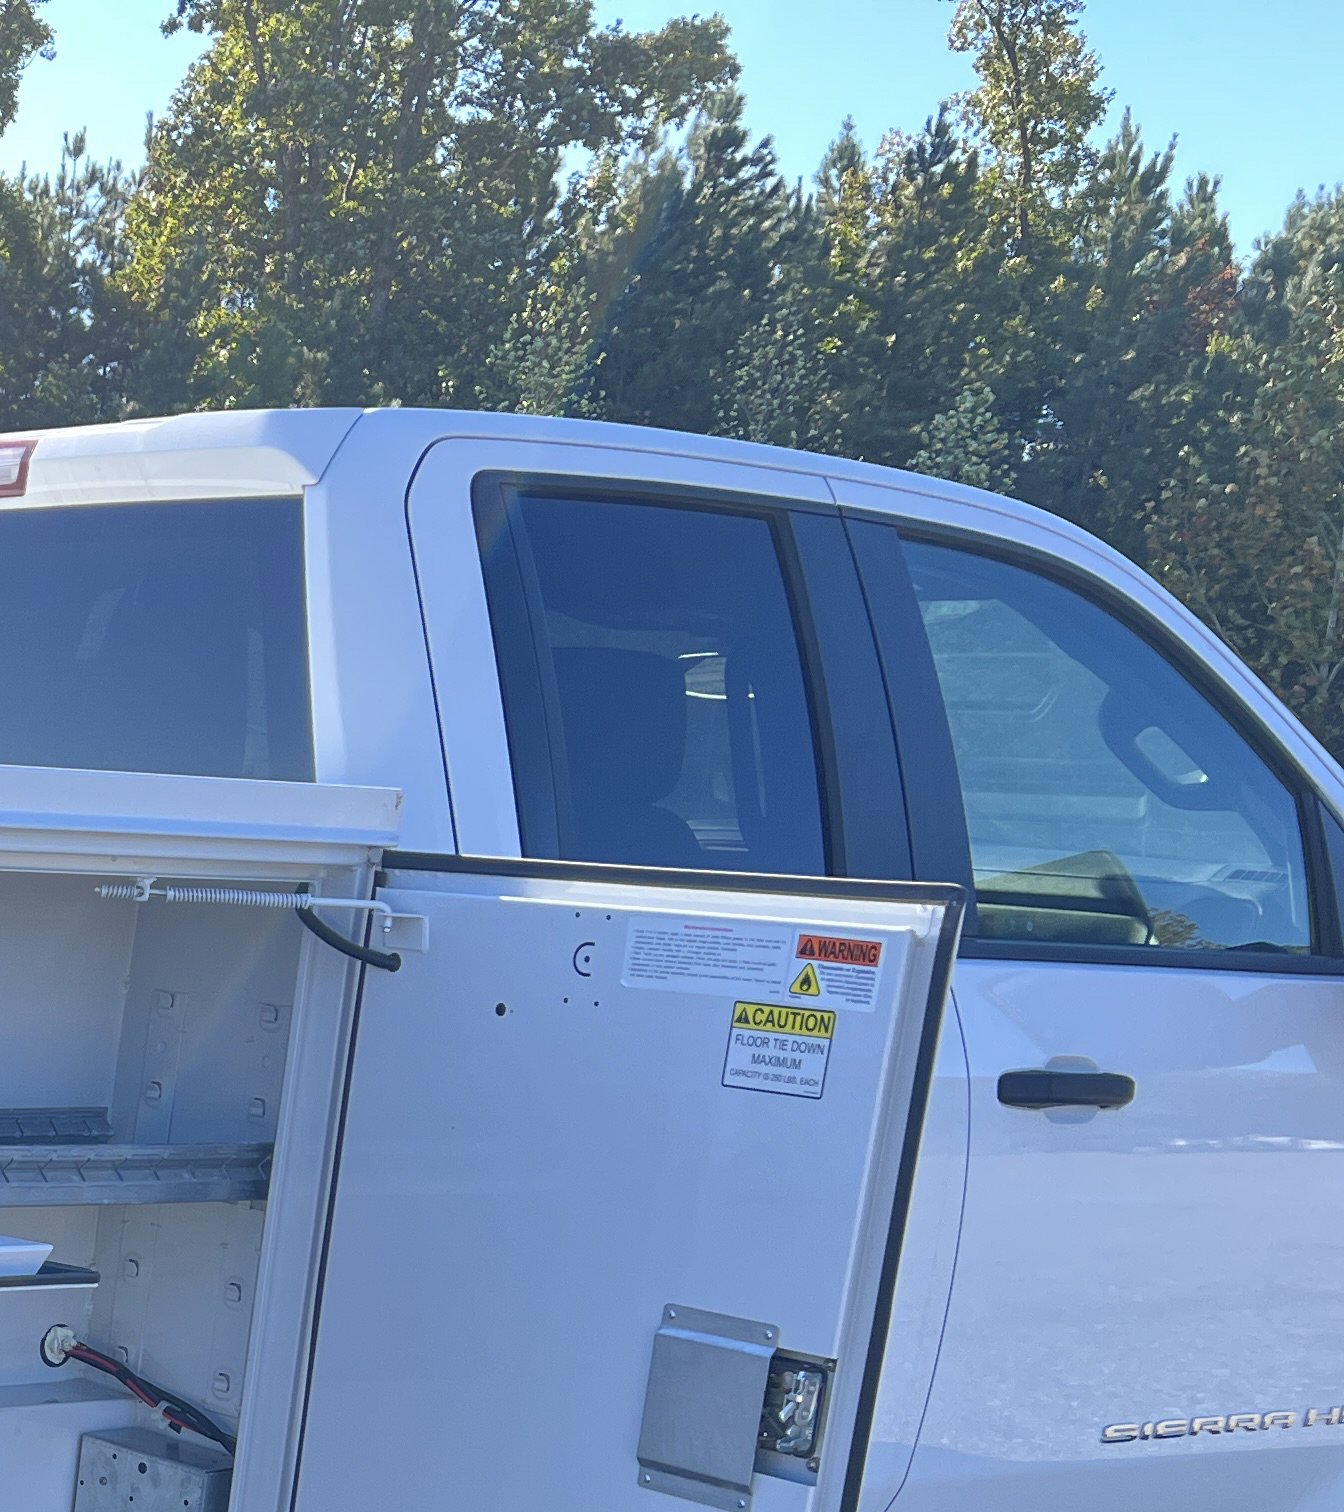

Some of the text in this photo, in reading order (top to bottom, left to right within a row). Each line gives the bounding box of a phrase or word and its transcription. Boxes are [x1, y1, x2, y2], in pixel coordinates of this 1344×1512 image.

[818, 940, 878, 963] WARNING
[752, 1008, 832, 1034] CAUTION
[735, 1033, 825, 1055] FLOOR TIE DOWN
[751, 1053, 802, 1070] MAXIMUM
[729, 1068, 762, 1080] CAPACITY
[799, 1077, 819, 1088] EACH
[1100, 1405, 1344, 1443] SIERRA H
